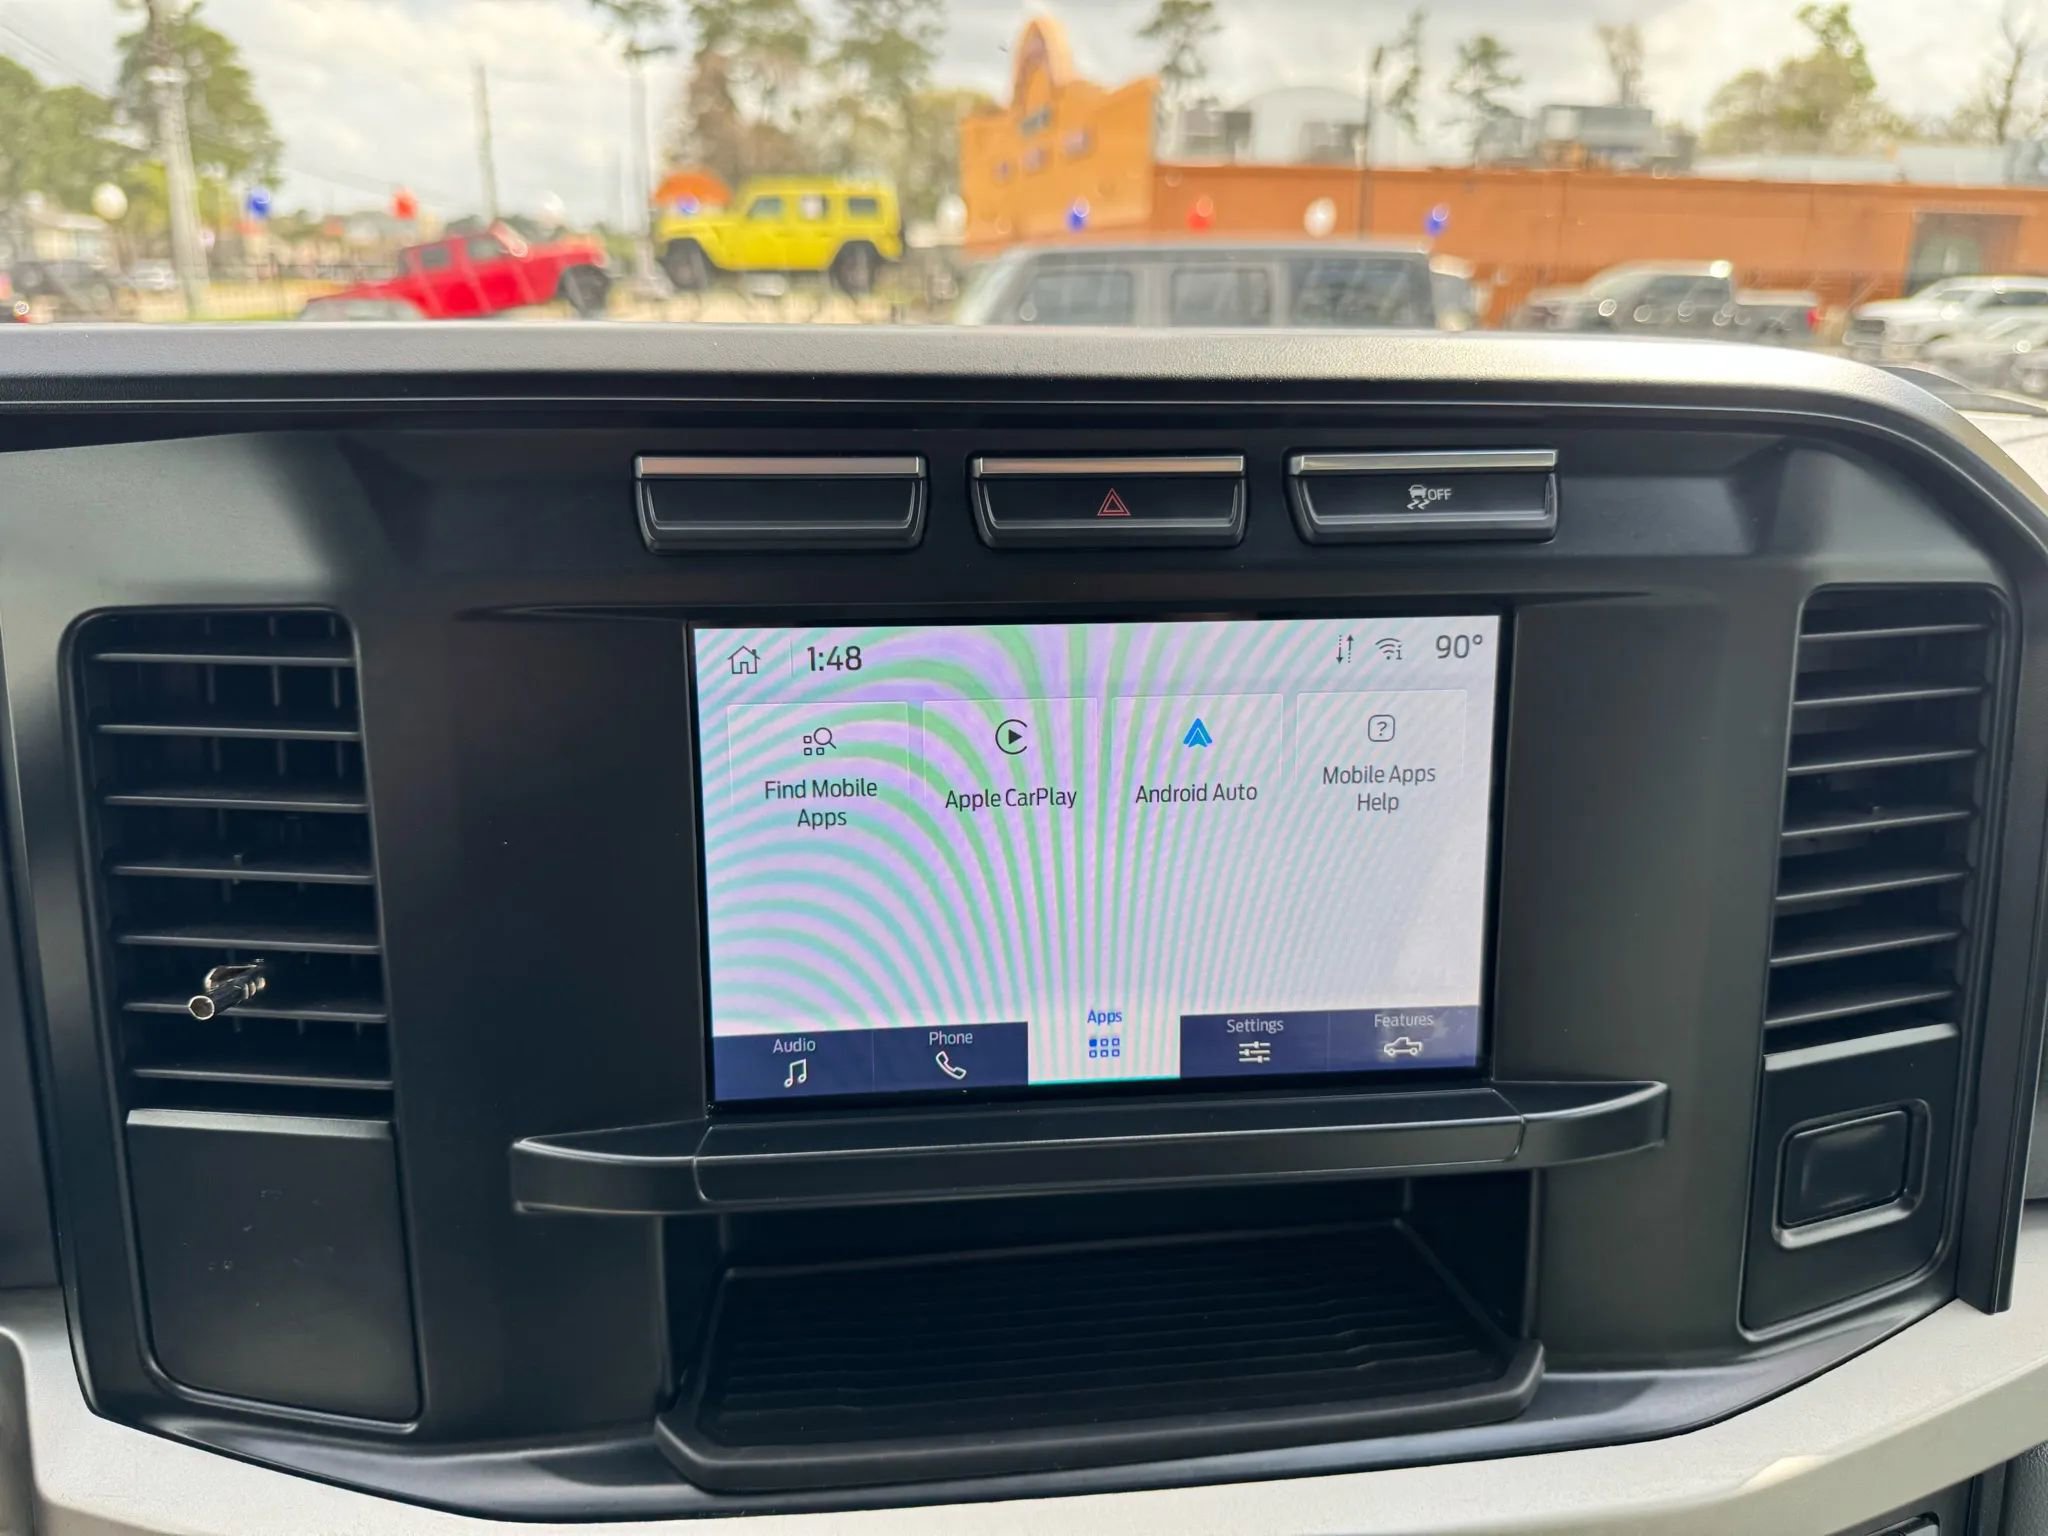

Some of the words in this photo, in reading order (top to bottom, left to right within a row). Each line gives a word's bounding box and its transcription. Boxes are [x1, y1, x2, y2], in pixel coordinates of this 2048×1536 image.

[1427, 488, 1452, 501] OFF
[806, 645, 862, 671] 1:48
[1322, 765, 1385, 785] Mobile
[1388, 765, 1436, 785] Apps
[765, 780, 807, 800] Find
[811, 778, 878, 799] Mobile
[945, 788, 1001, 811] Apple
[1005, 787, 1077, 809] CarPlay
[1136, 784, 1208, 803] Android
[1212, 783, 1258, 801] Auto
[1357, 792, 1400, 813] Help
[797, 808, 847, 829] Apps
[1087, 1008, 1122, 1025] Apps
[1226, 1018, 1284, 1035] Settings
[1374, 1012, 1434, 1028] Features
[772, 1037, 816, 1053] Audio
[929, 1031, 973, 1046] Phone
